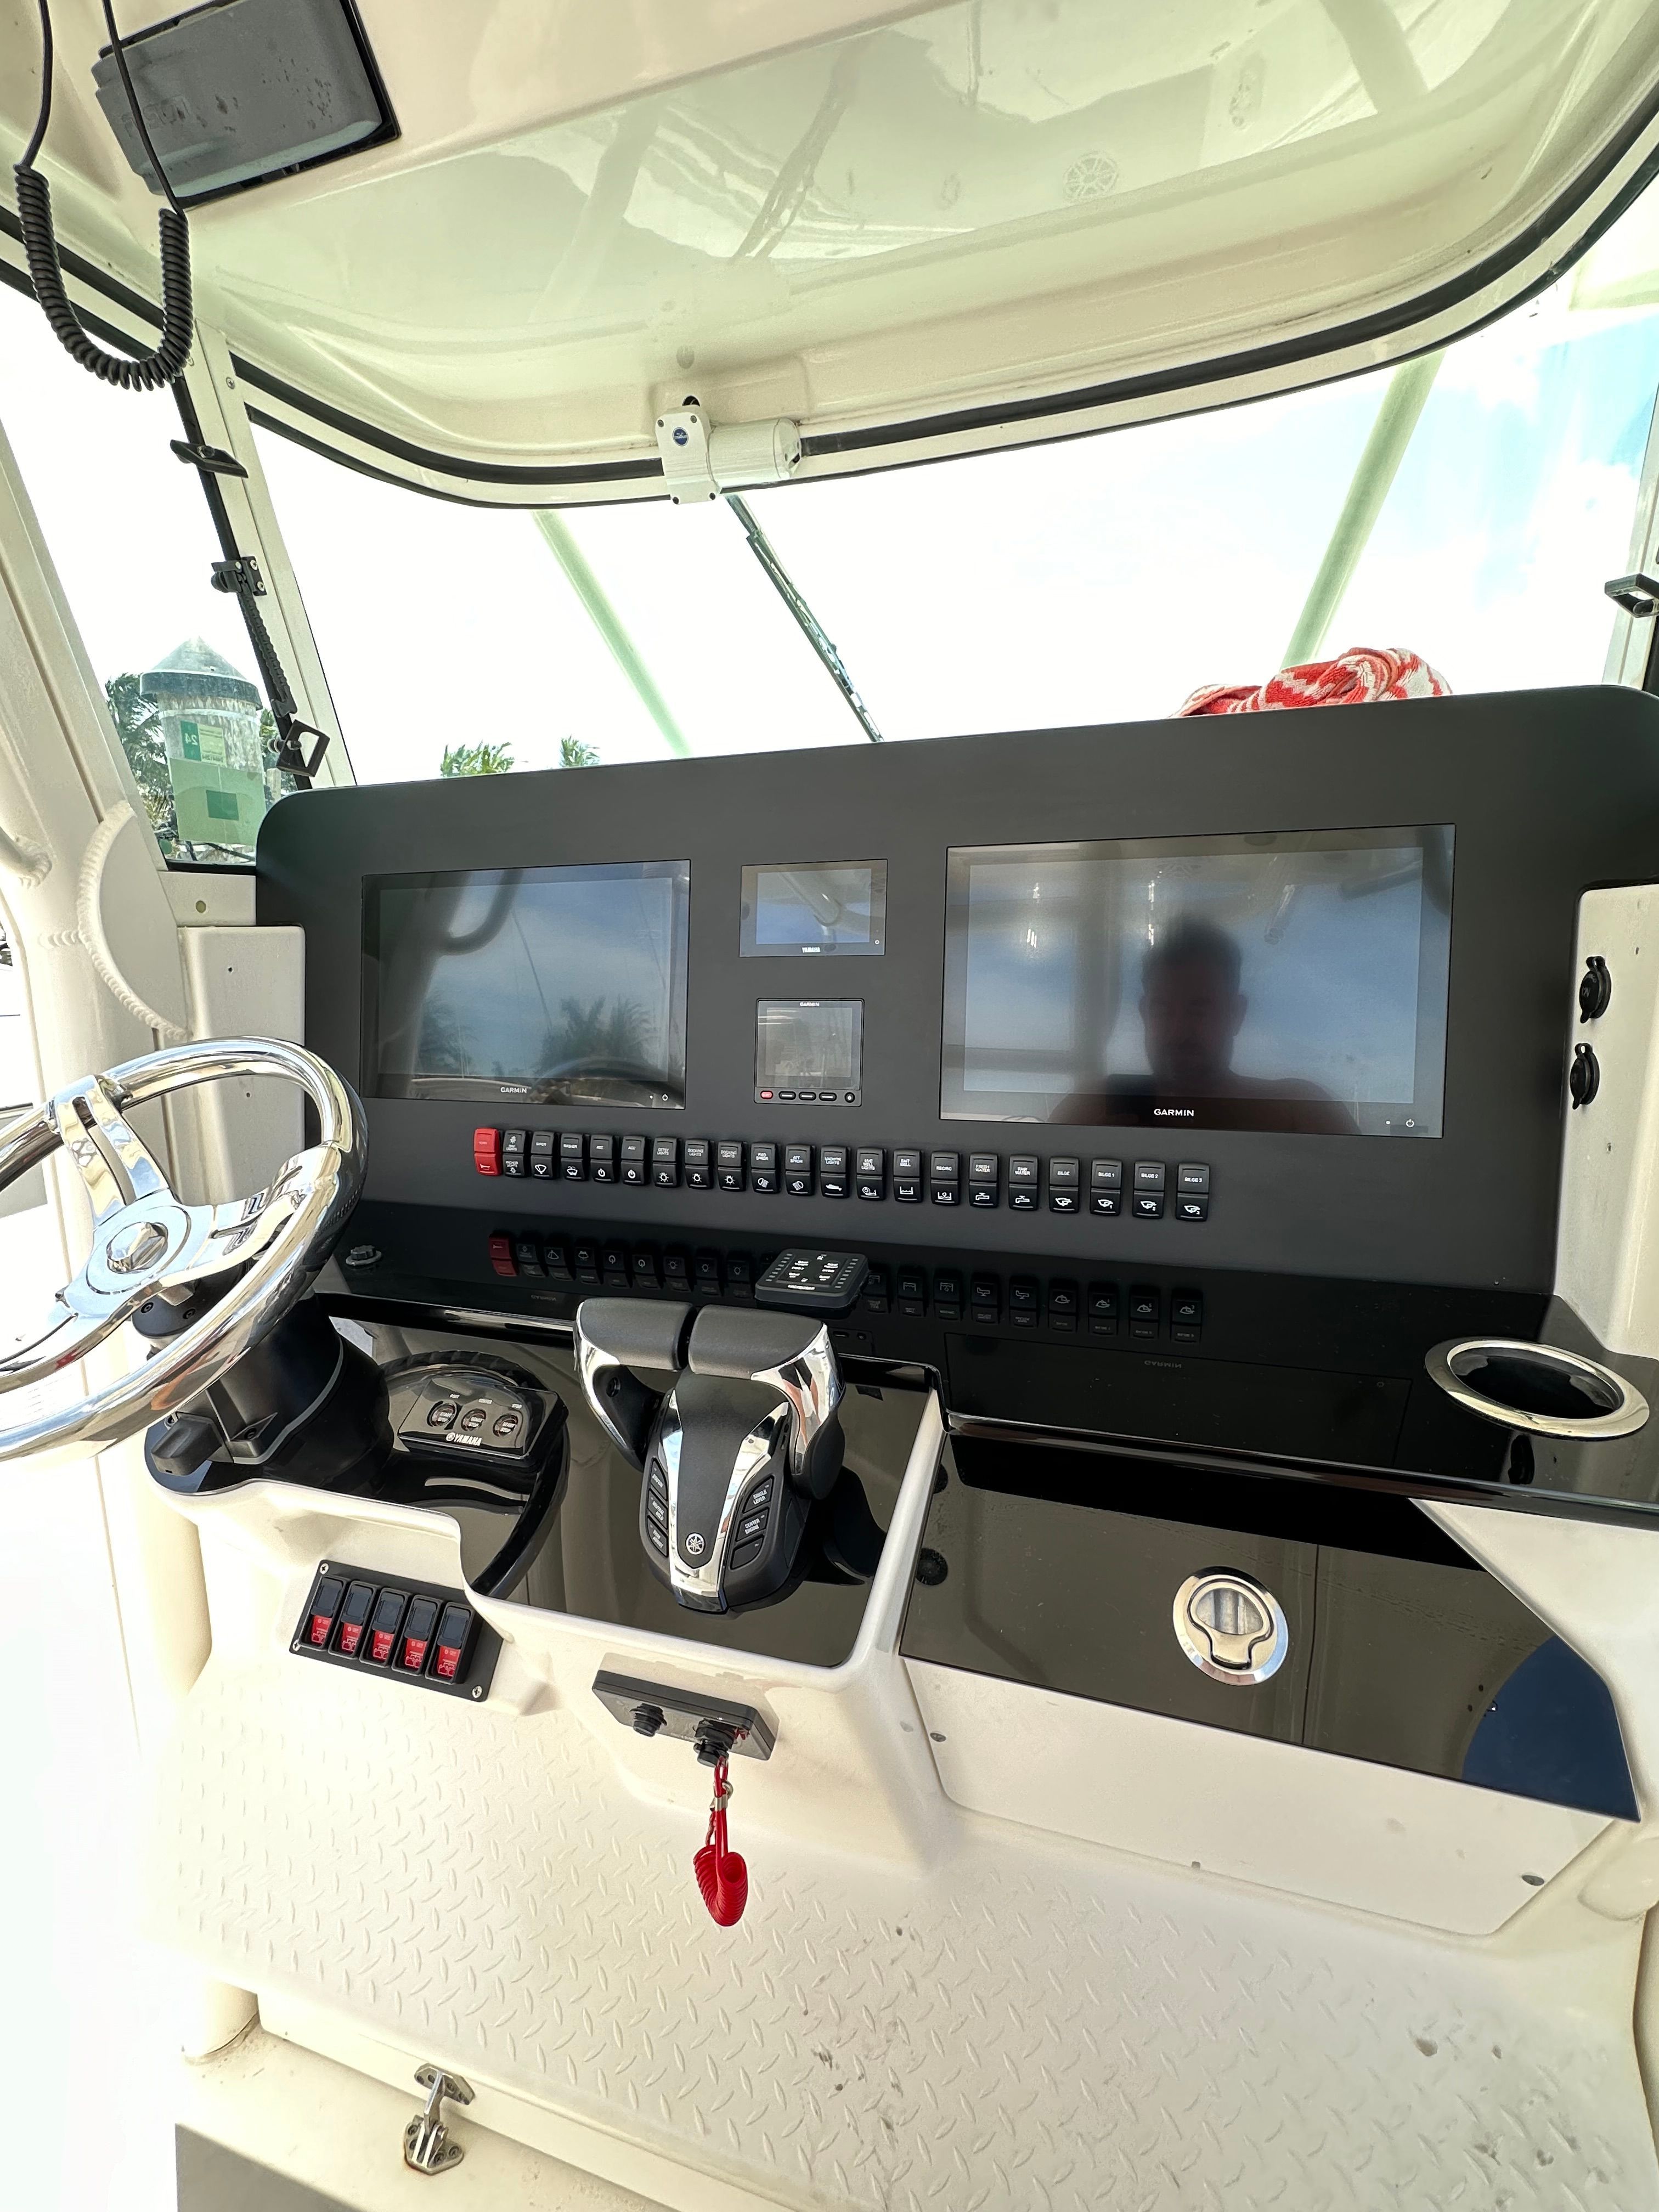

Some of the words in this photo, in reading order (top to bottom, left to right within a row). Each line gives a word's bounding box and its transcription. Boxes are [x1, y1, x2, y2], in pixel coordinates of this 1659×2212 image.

[1154, 1108, 1194, 1116] GARMIN
[454, 1434, 483, 1446] YAMAHA
[753, 1489, 768, 1499] SINGLE
[753, 1496, 766, 1505] LEVER
[744, 1517, 760, 1528] CENTER
